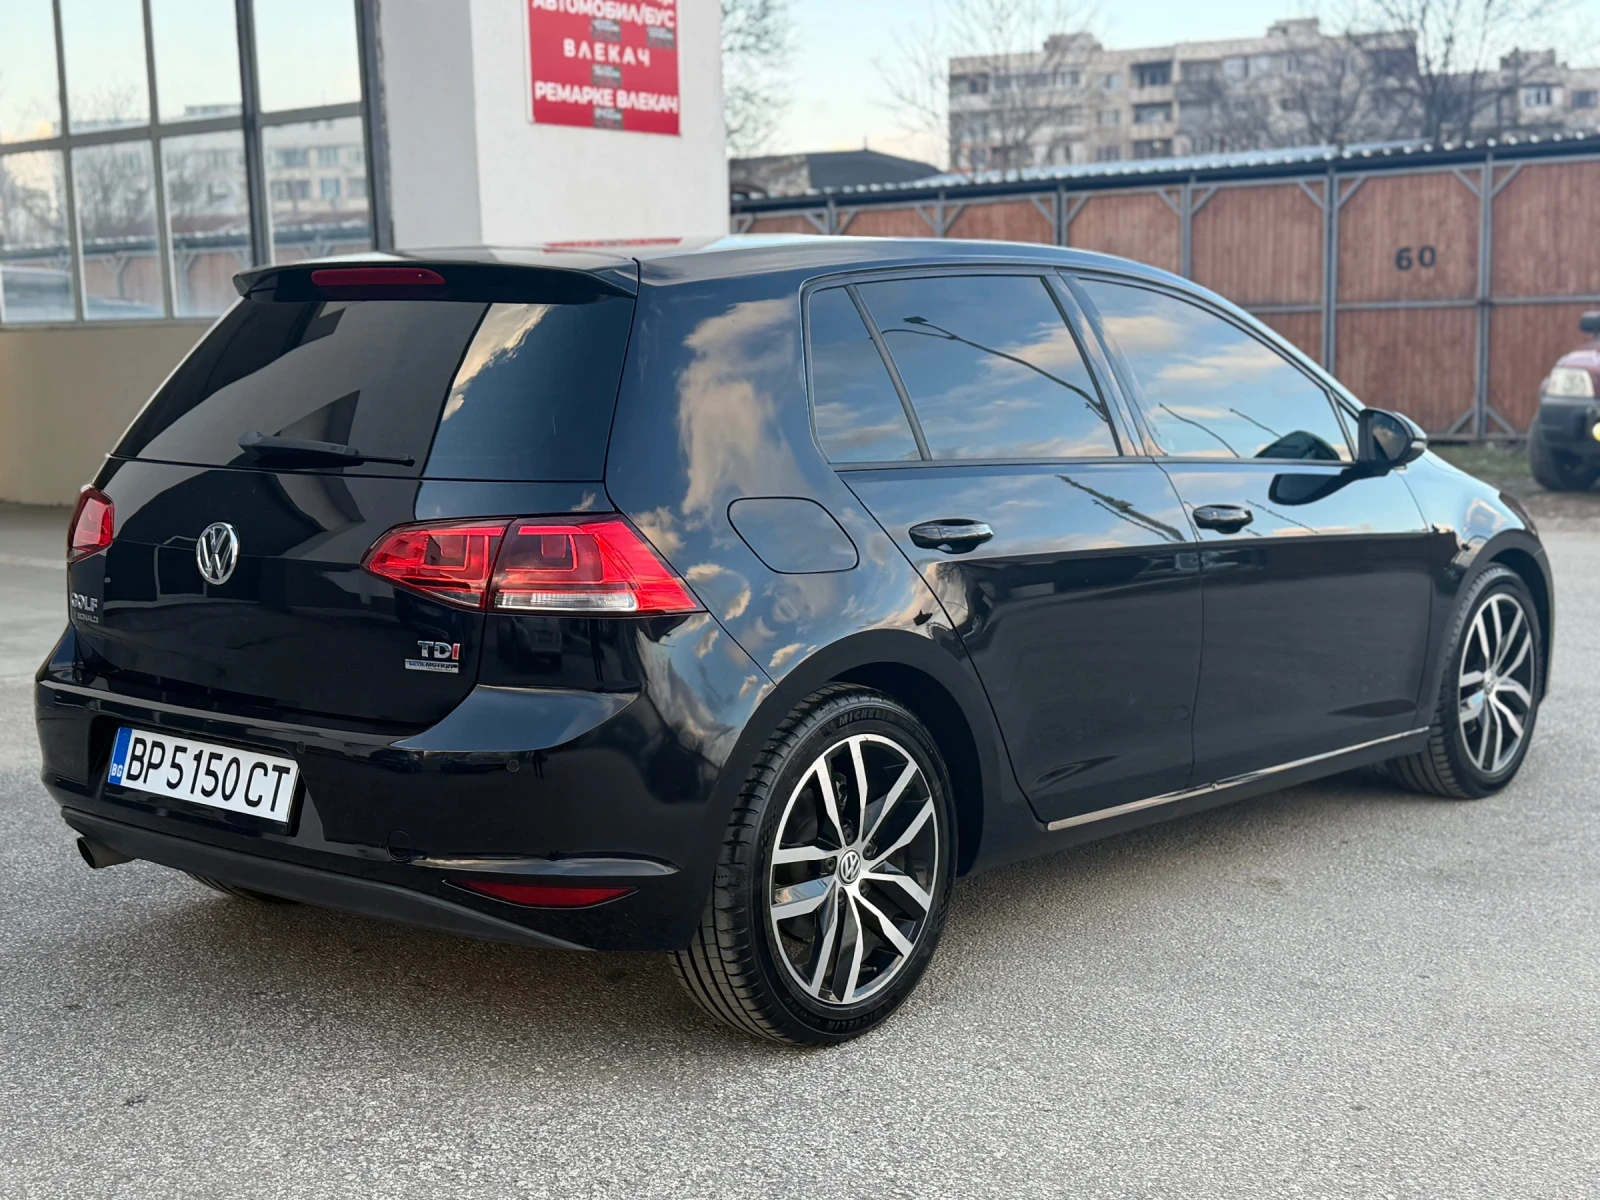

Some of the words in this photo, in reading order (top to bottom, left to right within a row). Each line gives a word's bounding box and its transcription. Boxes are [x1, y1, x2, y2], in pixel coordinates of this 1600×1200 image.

[563, 38, 650, 67] ВЛЕКАЧ
[534, 80, 614, 107] РЕМАРКЕ
[616, 89, 678, 114] ВЛЕКАЧ
[1395, 245, 1437, 271] 60
[71, 592, 98, 612] GOLF
[417, 640, 461, 660] TDI
[110, 762, 123, 778] BG
